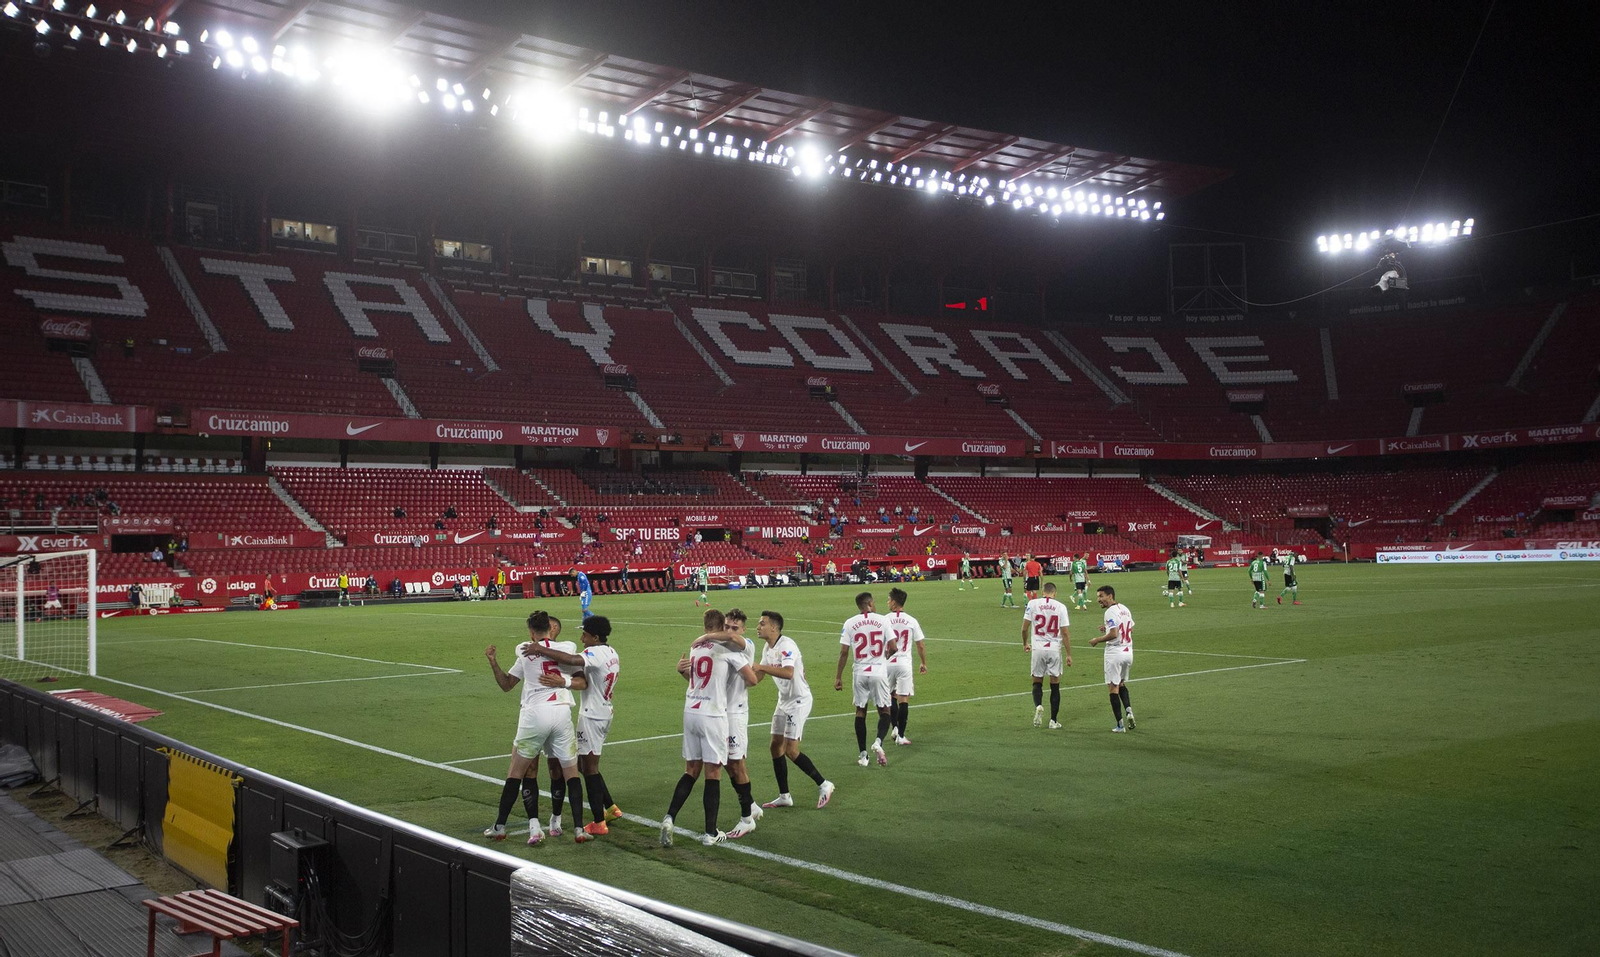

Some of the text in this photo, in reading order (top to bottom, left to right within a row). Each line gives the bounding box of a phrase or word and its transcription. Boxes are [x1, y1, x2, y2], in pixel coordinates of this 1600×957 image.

[1123, 315, 1134, 323] por
[1186, 315, 1198, 323] hoy
[526, 299, 615, 365] Y
[53, 409, 123, 425] CaixaBank
[209, 415, 289, 434] Cruzcampo
[436, 424, 503, 441] Cruzcampo
[521, 426, 579, 436] MARATHON
[1528, 426, 1583, 437] MARATHON
[759, 434, 808, 443] MARATHON
[1480, 431, 1518, 445] everfx
[821, 438, 870, 452] Cruzcampo
[961, 442, 1006, 455] Cruzcampo
[1066, 446, 1098, 455] CaixaBank
[1114, 445, 1154, 457] Cruzcampo
[1399, 440, 1442, 450] CaixaBank
[1210, 447, 1257, 458] Cruzcampo
[1137, 521, 1156, 530] everfx
[638, 528, 651, 540] TU
[654, 528, 680, 540] ERES
[762, 527, 809, 538] MI PASION
[41, 536, 88, 548] everfx
[244, 536, 288, 545] CaixaBank
[227, 581, 256, 591] LaLiga
[852, 619, 883, 631] FERNANDO
[1034, 614, 1059, 638] 24
[854, 630, 884, 659] 25
[542, 661, 562, 678] 5
[690, 655, 713, 690] 19
